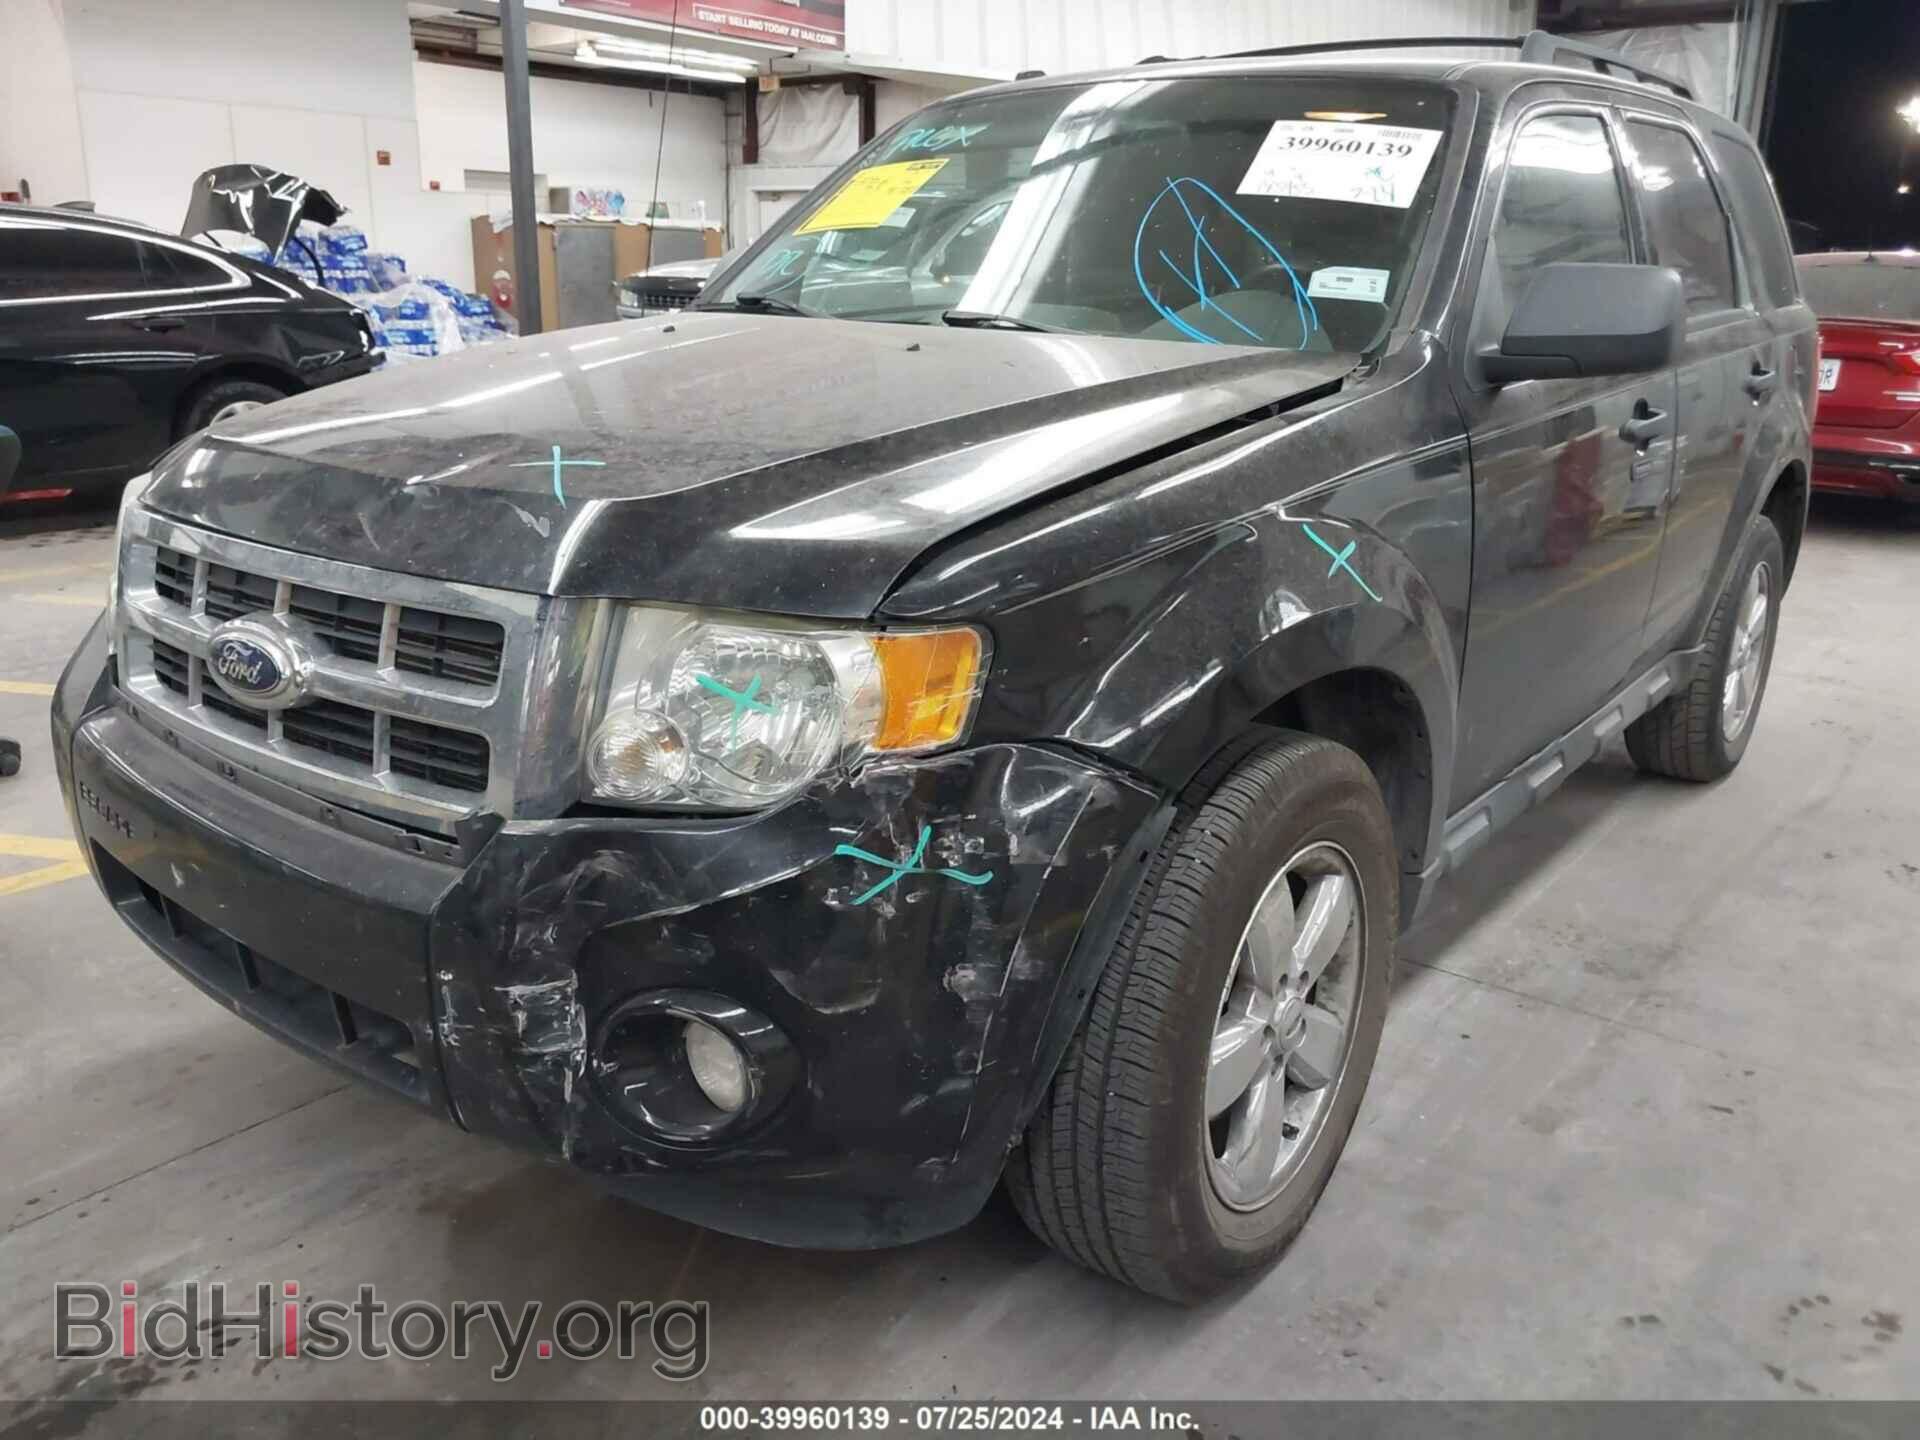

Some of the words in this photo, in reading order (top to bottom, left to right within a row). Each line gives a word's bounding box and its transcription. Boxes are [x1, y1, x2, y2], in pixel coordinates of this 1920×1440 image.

[698, 11, 727, 24] START
[728, 15, 764, 31] SELLING
[763, 21, 790, 36] TODAY
[790, 28, 801, 39] AT
[1279, 136, 1413, 158] 39960139
[218, 642, 264, 685] Ford
